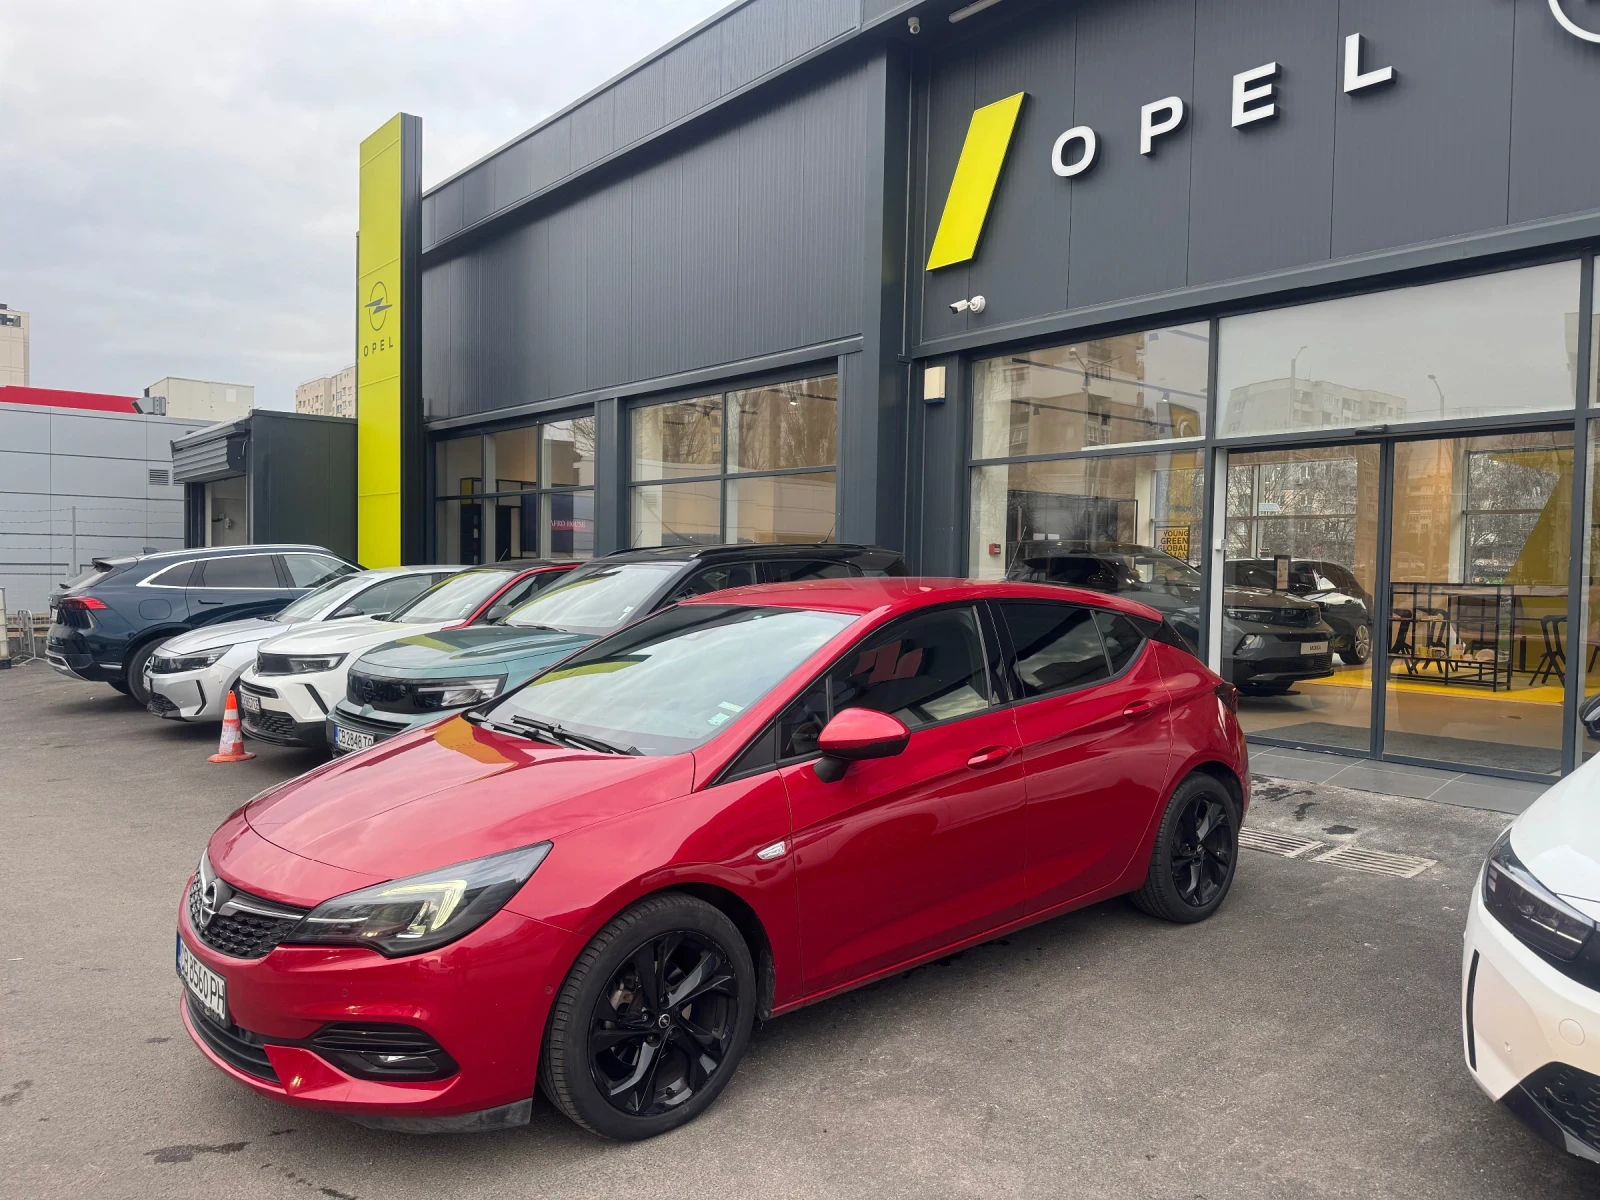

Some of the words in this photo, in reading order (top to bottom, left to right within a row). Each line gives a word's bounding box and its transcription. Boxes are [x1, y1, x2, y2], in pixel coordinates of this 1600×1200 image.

[1051, 32, 1397, 178] OPEL
[363, 336, 394, 358] OPEL
[566, 520, 586, 528] HOUSE
[1157, 544, 1189, 552] GLOBAL
[1160, 537, 1189, 545] GREEN
[346, 731, 363, 749] 2848
[209, 975, 226, 1015] PH
